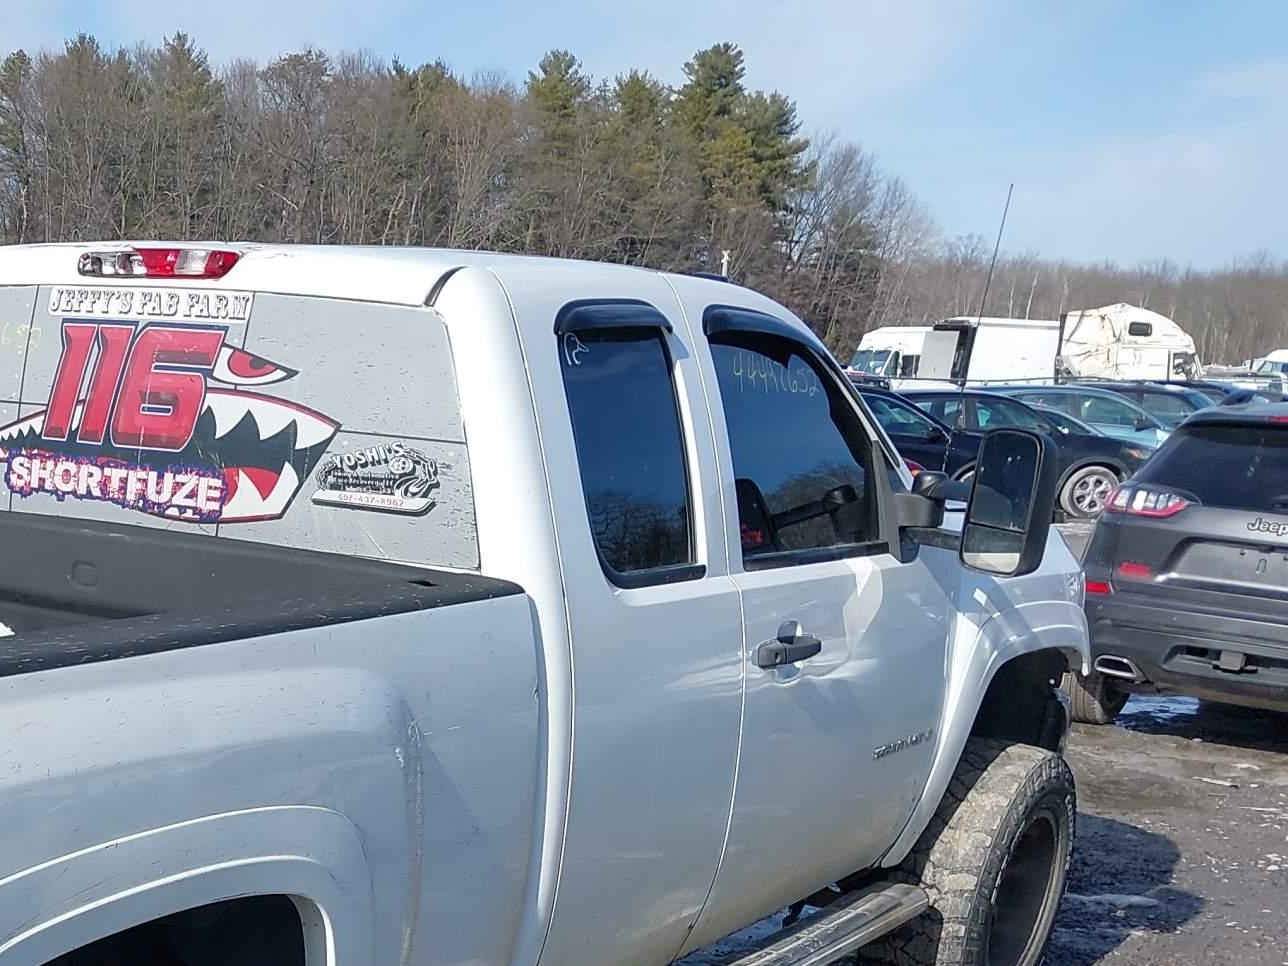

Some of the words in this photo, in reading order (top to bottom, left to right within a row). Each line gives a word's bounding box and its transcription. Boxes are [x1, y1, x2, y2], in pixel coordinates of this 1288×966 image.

[50, 287, 134, 315] JEFFY'S
[136, 291, 179, 317] FAB
[183, 292, 250, 320] FARM
[42, 318, 229, 452] 116
[332, 441, 404, 468] YOSHI'S
[9, 455, 223, 511] SHORTFUZE
[1247, 517, 1288, 536] Jeep
